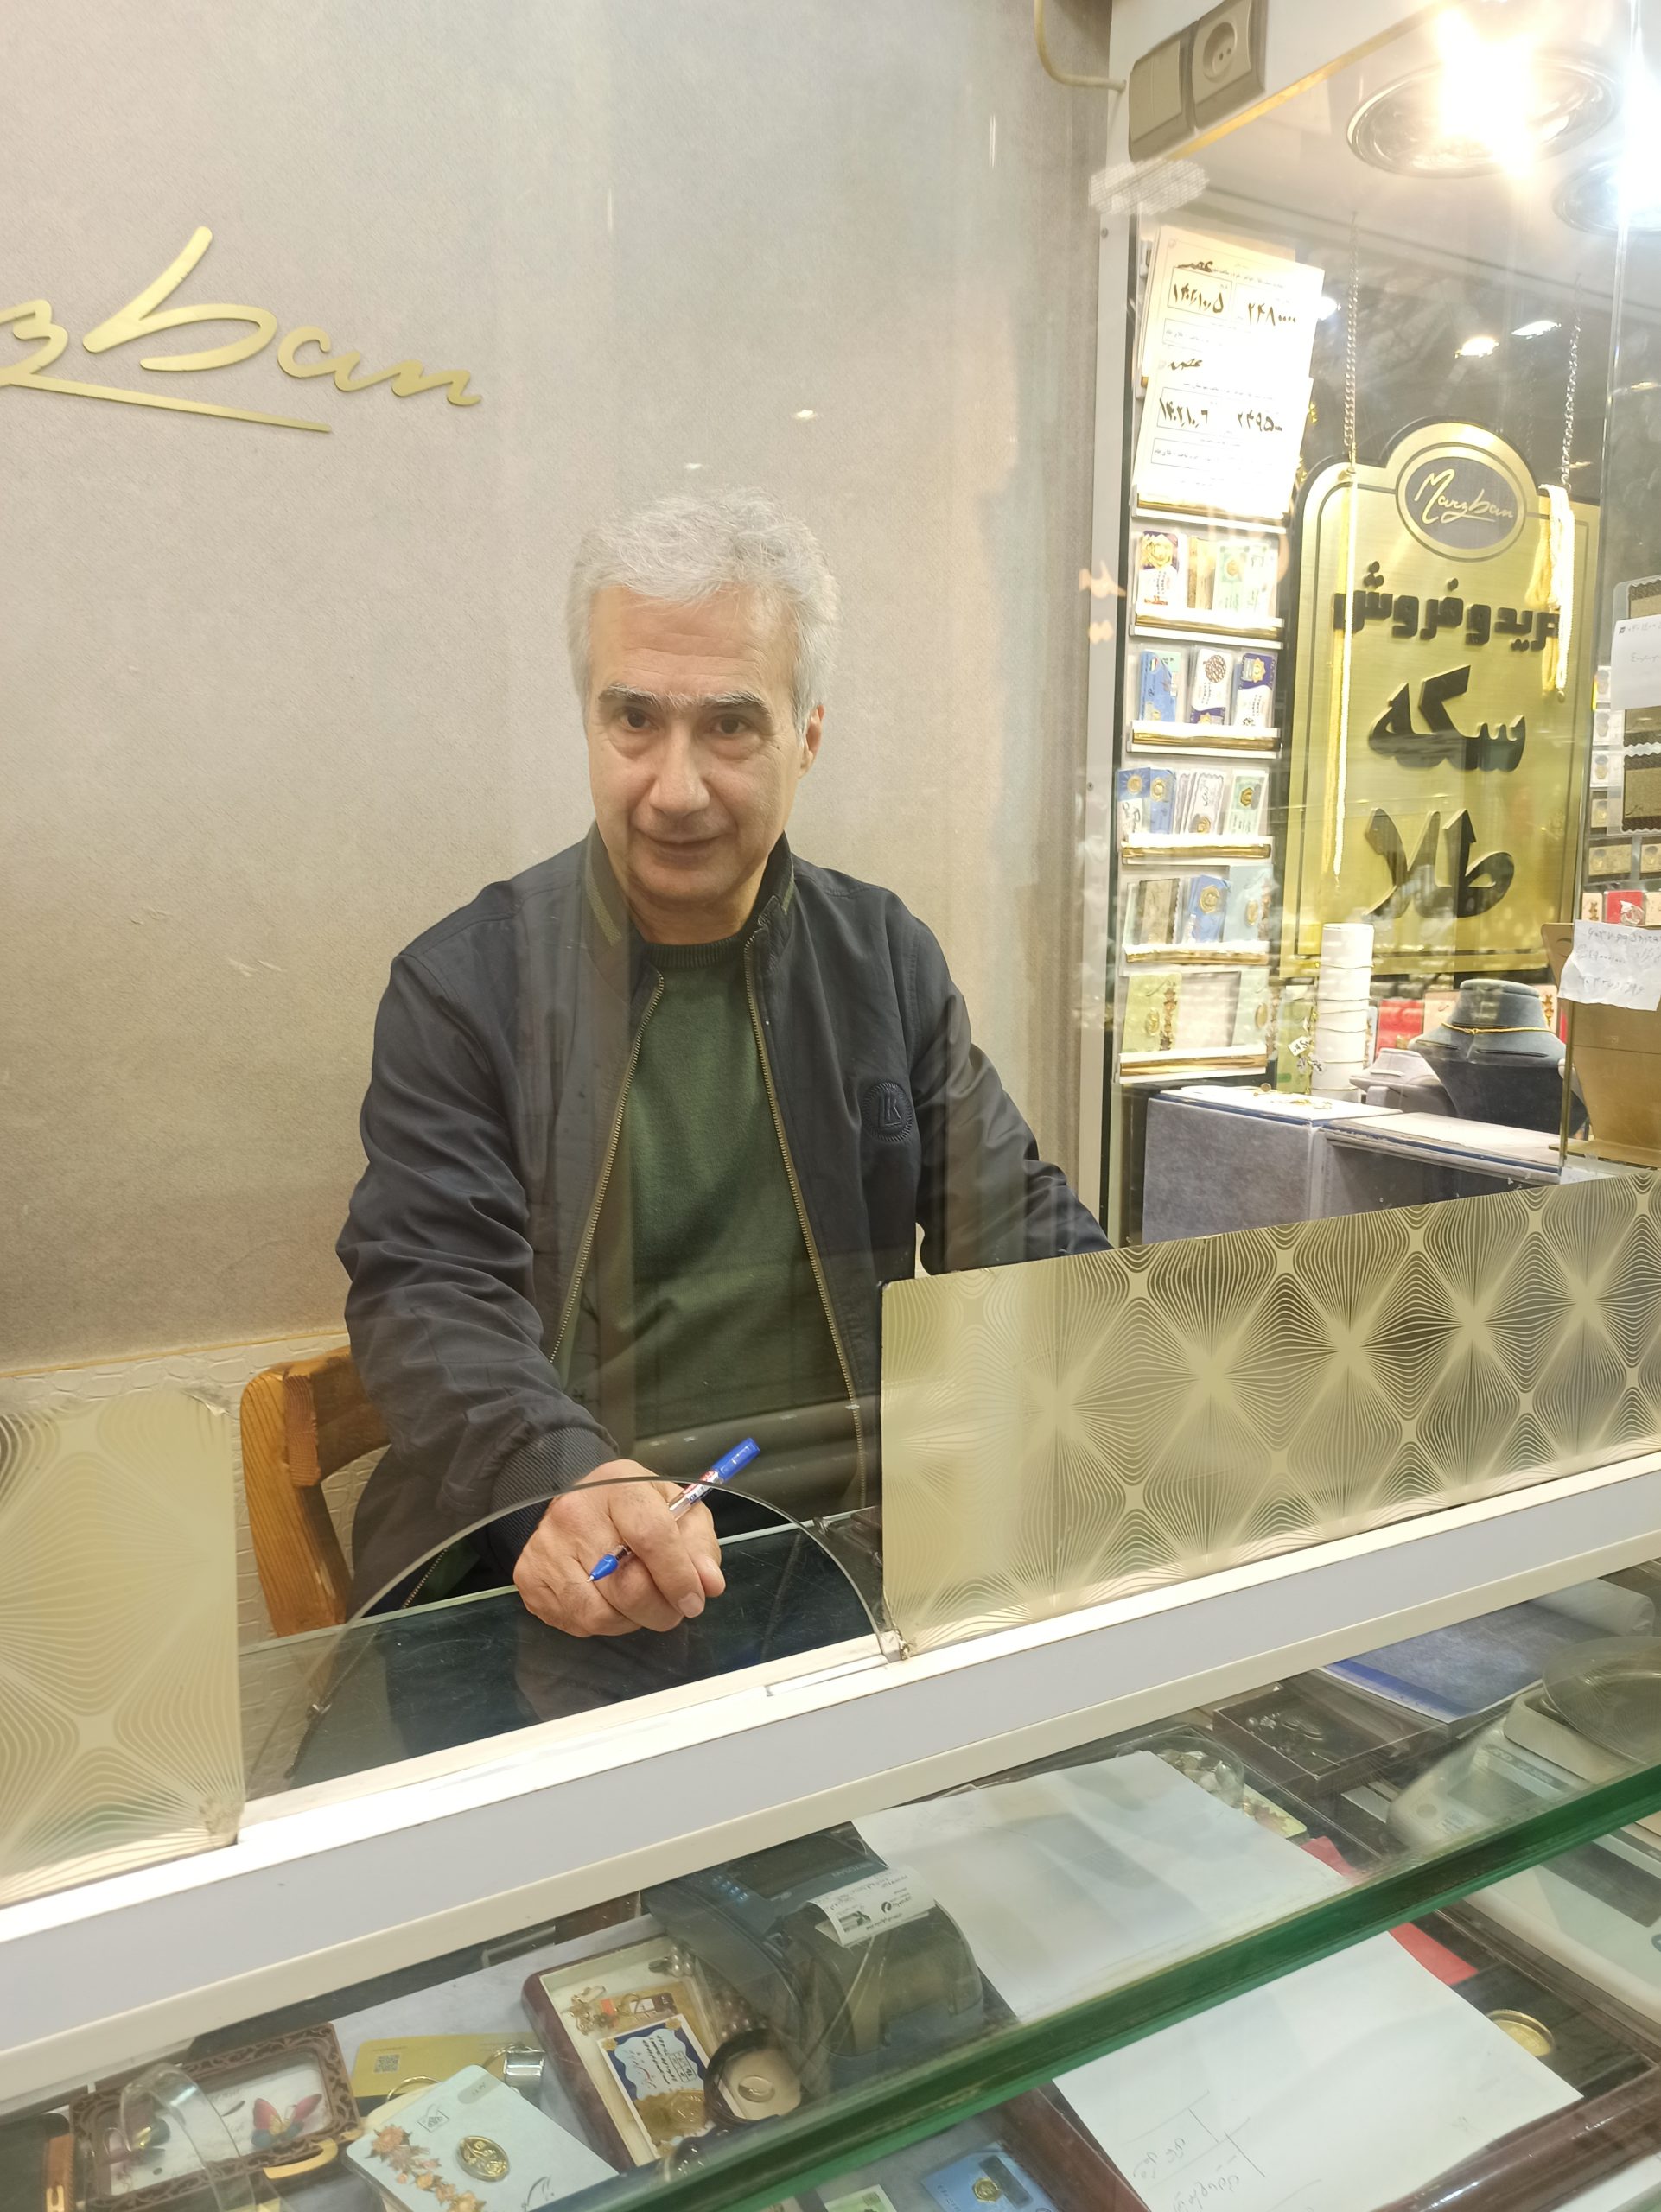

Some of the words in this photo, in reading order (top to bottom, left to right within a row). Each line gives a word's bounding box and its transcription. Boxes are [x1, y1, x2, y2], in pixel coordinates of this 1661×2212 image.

[1414, 468, 1514, 524] Marzban
[1368, 664, 1526, 772] سکه
[1363, 807, 1515, 919] طلا
